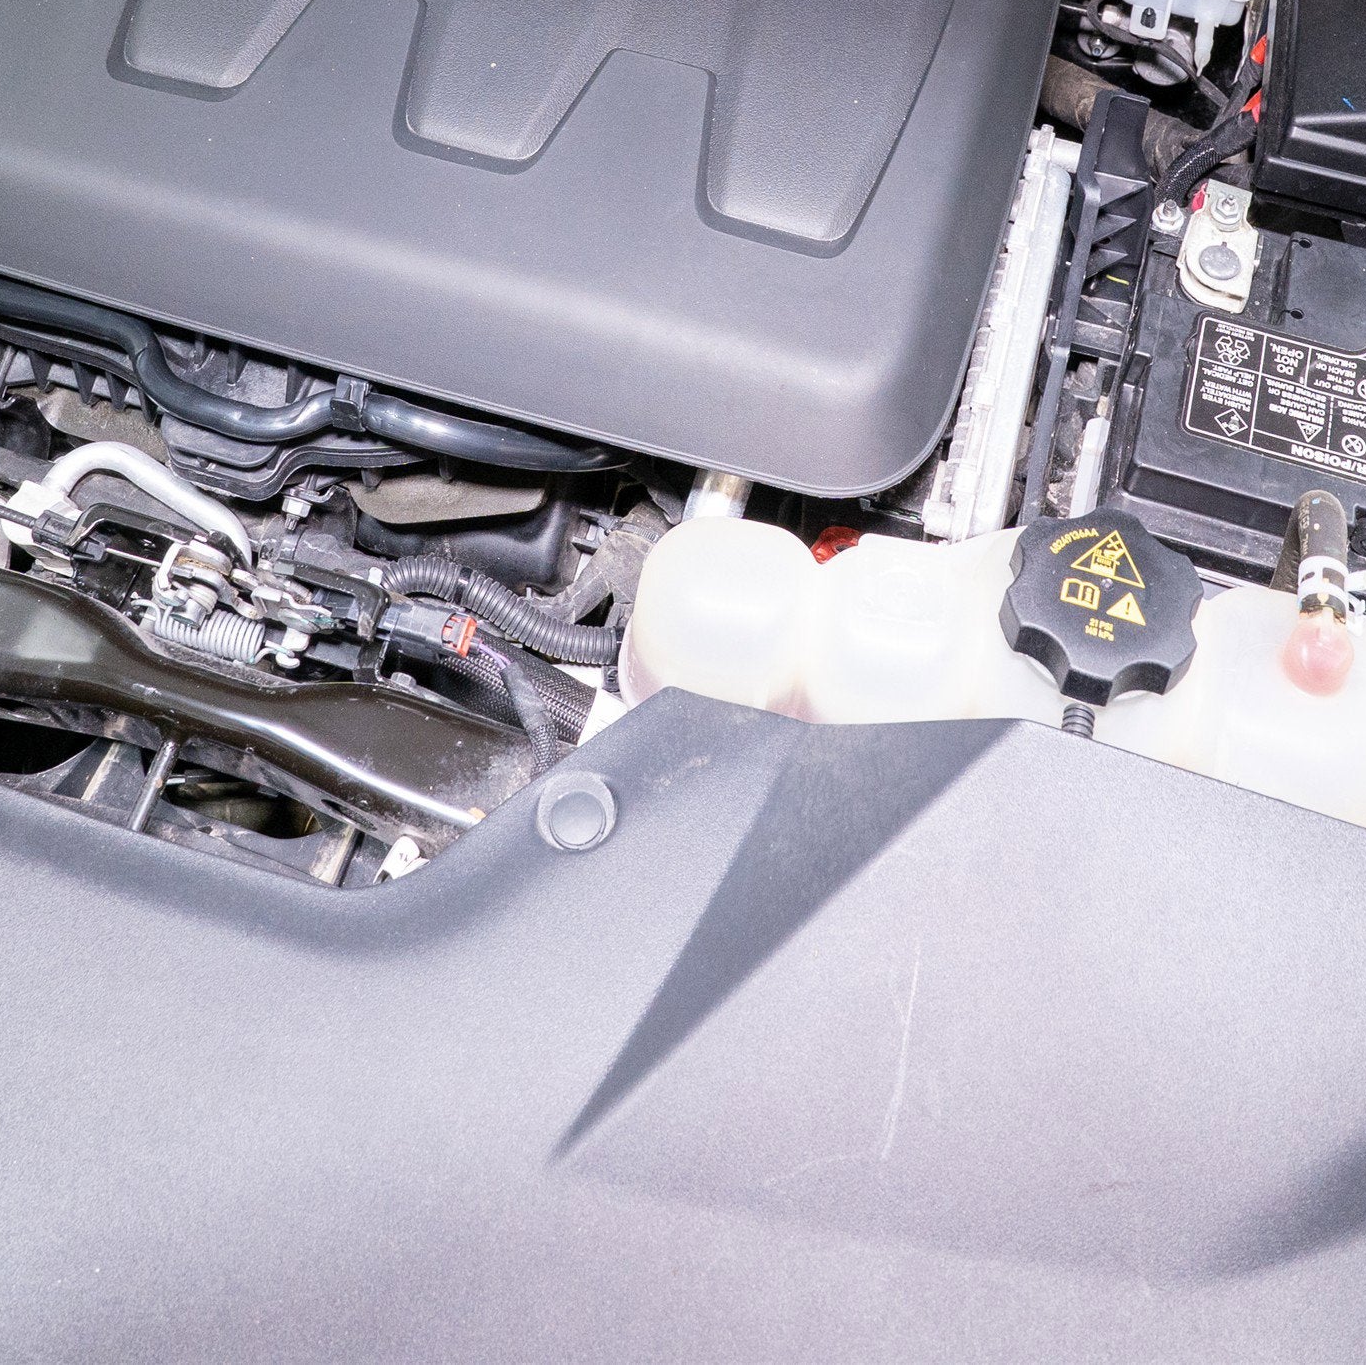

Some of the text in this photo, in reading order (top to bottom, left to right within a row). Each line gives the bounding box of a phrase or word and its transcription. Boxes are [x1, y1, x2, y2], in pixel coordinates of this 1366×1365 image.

[1269, 342, 1303, 359] OPEN.
[1273, 352, 1298, 367] NOT
[1315, 352, 1357, 369] CHILDREN.
[1201, 367, 1254, 387] GET MEDICAL
[1211, 363, 1254, 381] HELP FAST.
[1276, 362, 1294, 375] DO
[1315, 362, 1355, 378] REACH OF
[1314, 378, 1353, 395] KEEP OUT
[1327, 373, 1354, 386] OF THE
[1200, 384, 1251, 405] IMMEDIATELY
[1202, 379, 1252, 398] WITH WATER.
[1264, 377, 1326, 401] SEVERE BURNS.
[1224, 398, 1250, 412] FLUSH
[1268, 387, 1326, 408] BLINDNESS OR
[1269, 403, 1324, 424] SULFURIC ACID
[1280, 398, 1325, 416] CAN CAUSE
[1099, 620, 1113, 632] PSI
